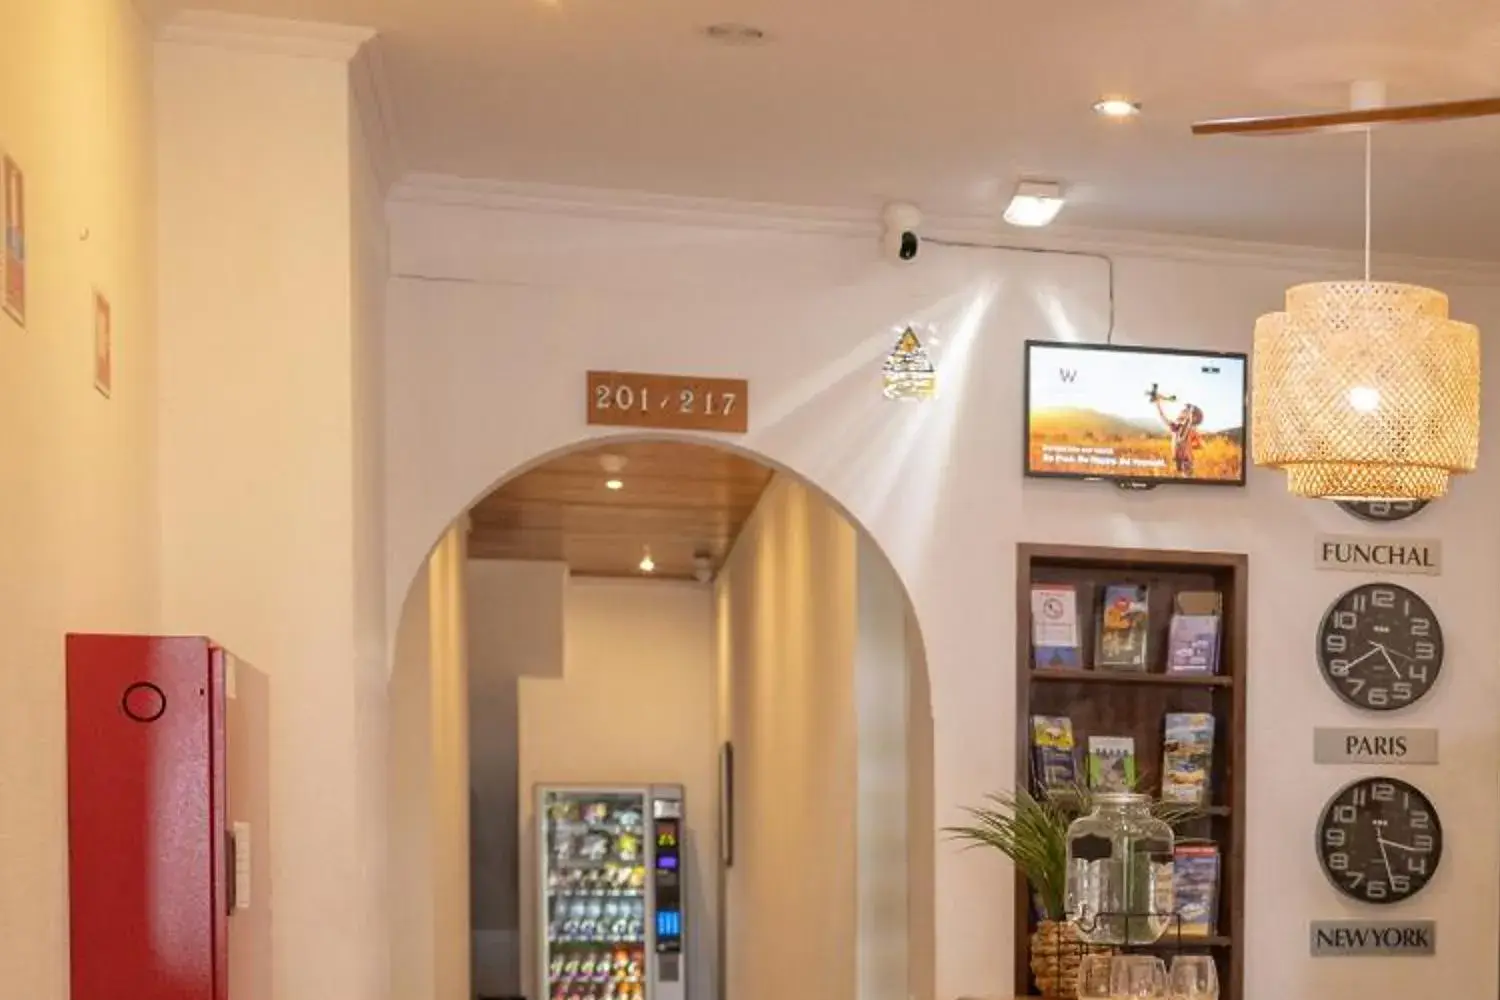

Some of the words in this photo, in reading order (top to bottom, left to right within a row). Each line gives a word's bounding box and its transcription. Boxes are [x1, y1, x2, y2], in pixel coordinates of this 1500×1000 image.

[1322, 542, 1436, 567] FUNCHAL
[1353, 594, 1366, 613] 11
[1371, 590, 1395, 608] 12
[1404, 600, 1410, 616] 1
[1333, 611, 1357, 629] 10
[1410, 618, 1430, 636] 2
[1326, 635, 1347, 653] 9
[1415, 642, 1434, 659] 3
[1408, 665, 1427, 684] 4
[1345, 678, 1367, 696] 7
[1367, 687, 1389, 705] 6
[1392, 682, 1412, 700] 5
[1346, 736, 1407, 756] PARIS
[1352, 787, 1366, 807] 11
[1371, 783, 1395, 801] 12
[1403, 792, 1409, 811] 1
[1333, 805, 1356, 823] 10
[1410, 810, 1429, 828] 2
[1326, 828, 1345, 846] 9
[1413, 834, 1432, 851] 3
[1330, 852, 1349, 870] 8
[1407, 857, 1425, 875] 4
[1345, 871, 1364, 889] 7
[1367, 881, 1386, 898] 6
